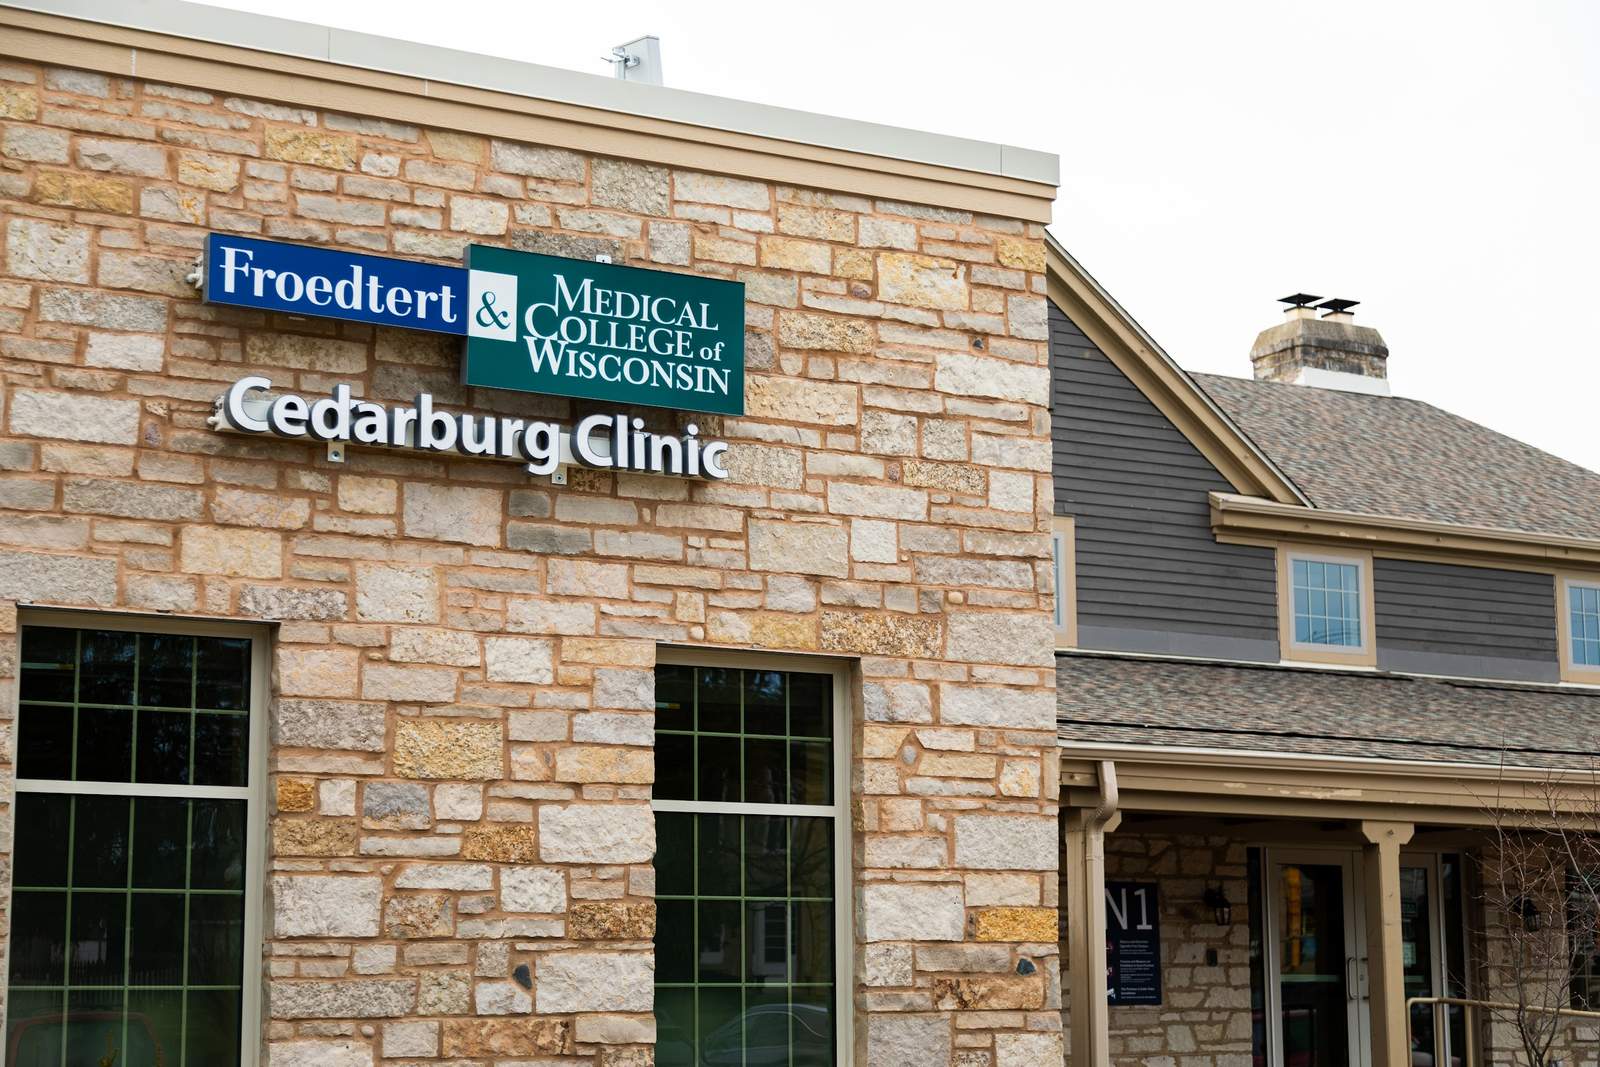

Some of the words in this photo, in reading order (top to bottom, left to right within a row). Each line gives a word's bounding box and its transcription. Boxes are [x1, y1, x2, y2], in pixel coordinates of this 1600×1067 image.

[219, 246, 457, 324] Froedtert
[475, 291, 511, 330] &
[553, 274, 719, 331] MEDICAL
[524, 302, 694, 359] COLLEGE
[699, 341, 725, 362] of
[523, 335, 731, 396] WISCONSIN
[226, 376, 560, 476] Cedarburg
[571, 413, 729, 480] Clinic
